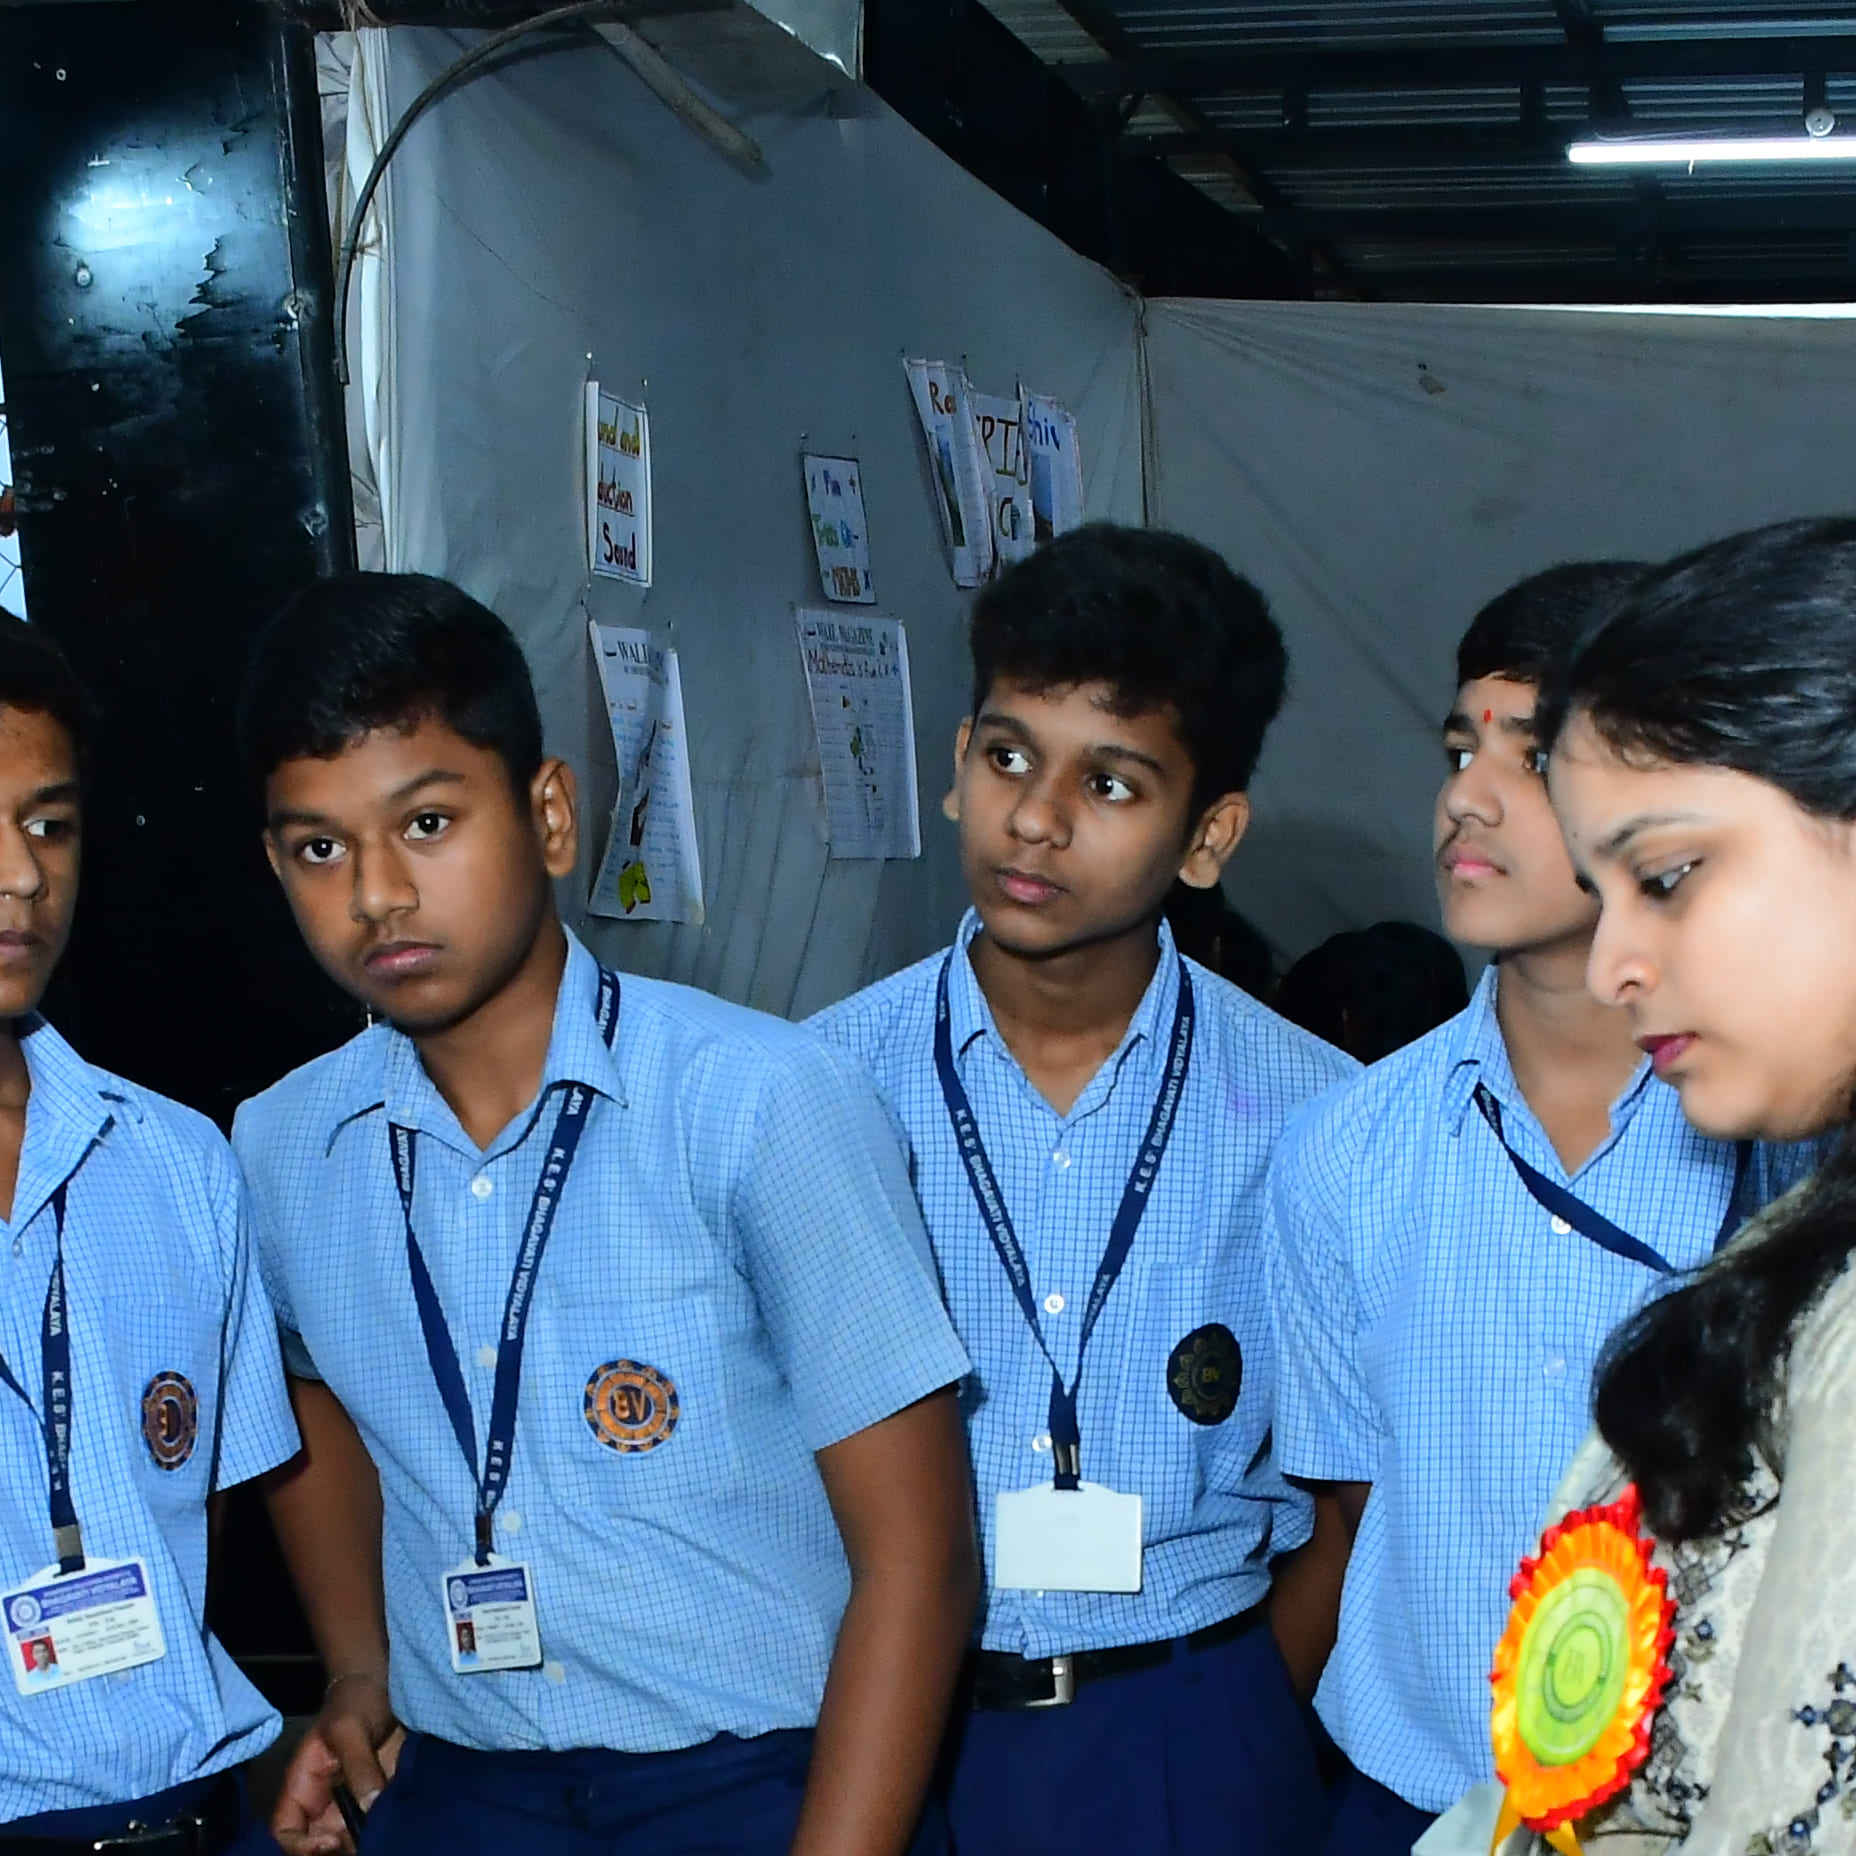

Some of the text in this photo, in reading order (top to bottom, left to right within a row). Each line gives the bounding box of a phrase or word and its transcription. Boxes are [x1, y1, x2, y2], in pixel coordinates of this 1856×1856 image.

[1151, 1080, 1179, 1147] BHAGAVATI
[1171, 1016, 1190, 1078] VIDYALAYA
[521, 1196, 551, 1269] BHAGAVATI
[969, 1154, 1002, 1223] BHAGAVATI
[995, 1222, 1025, 1287] VIDYALAYA
[506, 1270, 531, 1341] VIDYALAYA
[614, 1390, 646, 1420] BV
